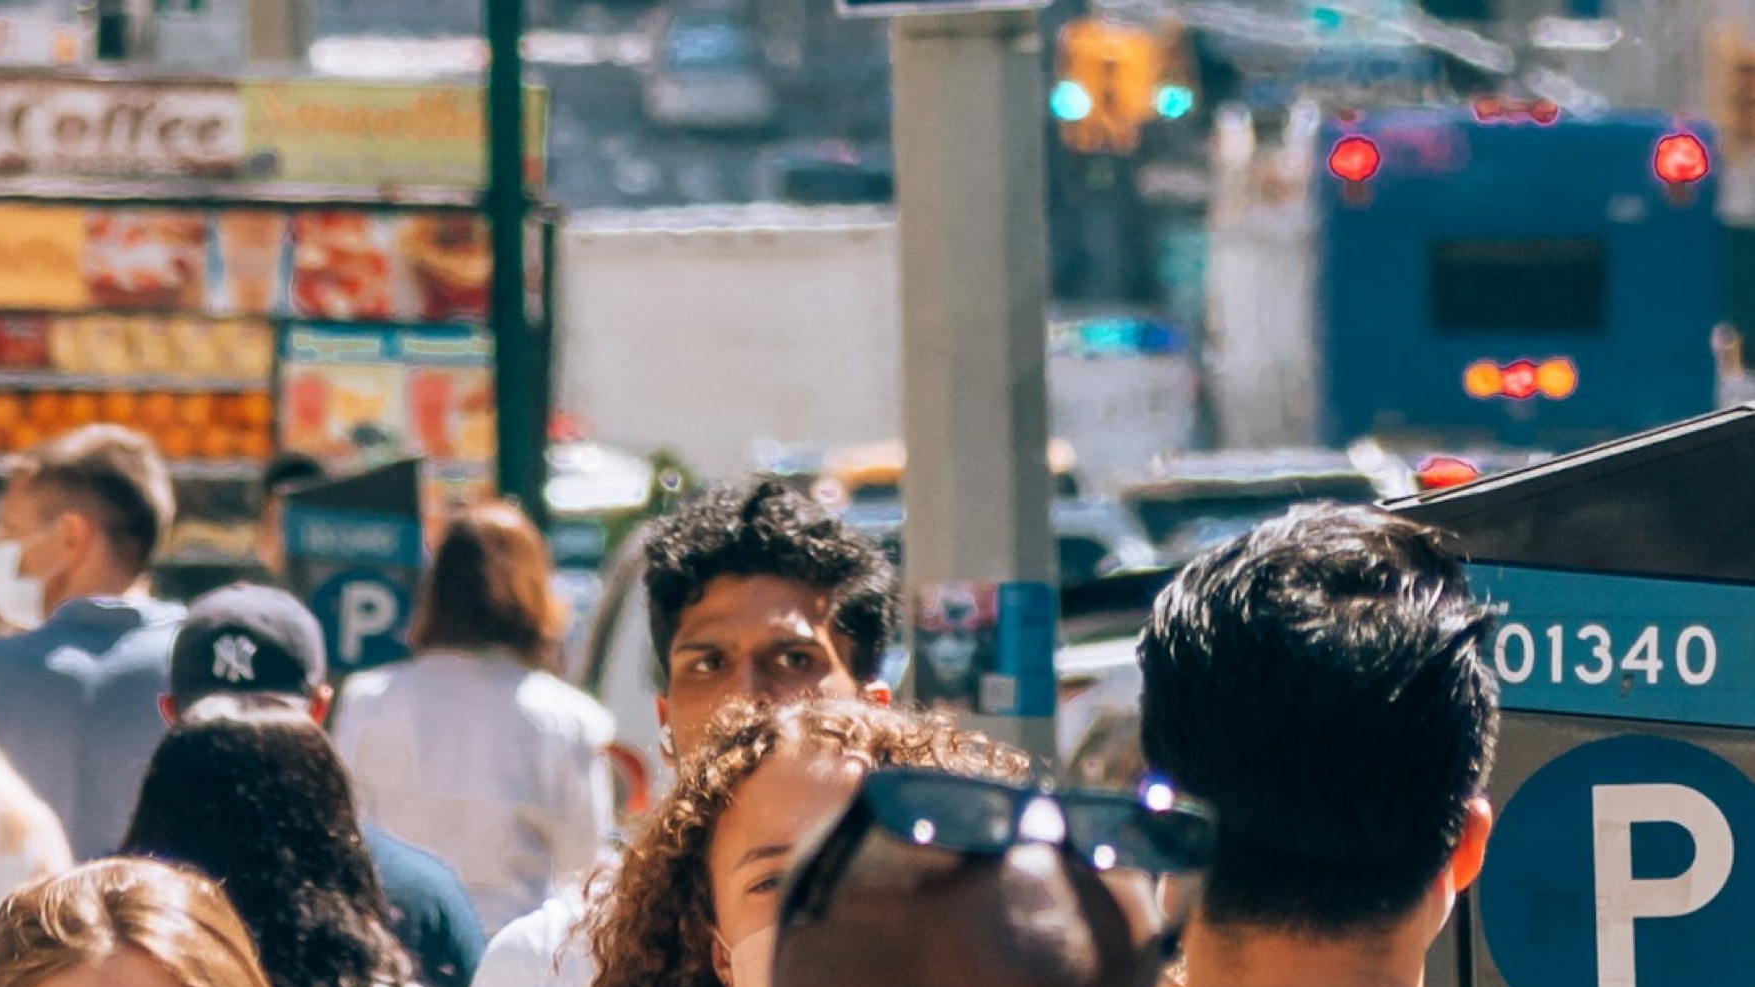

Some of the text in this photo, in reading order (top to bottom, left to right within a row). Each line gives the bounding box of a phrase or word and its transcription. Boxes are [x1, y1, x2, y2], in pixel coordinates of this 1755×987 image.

[1, 93, 231, 155] Coffee
[338, 580, 398, 664] P
[1496, 622, 1717, 686] 01340
